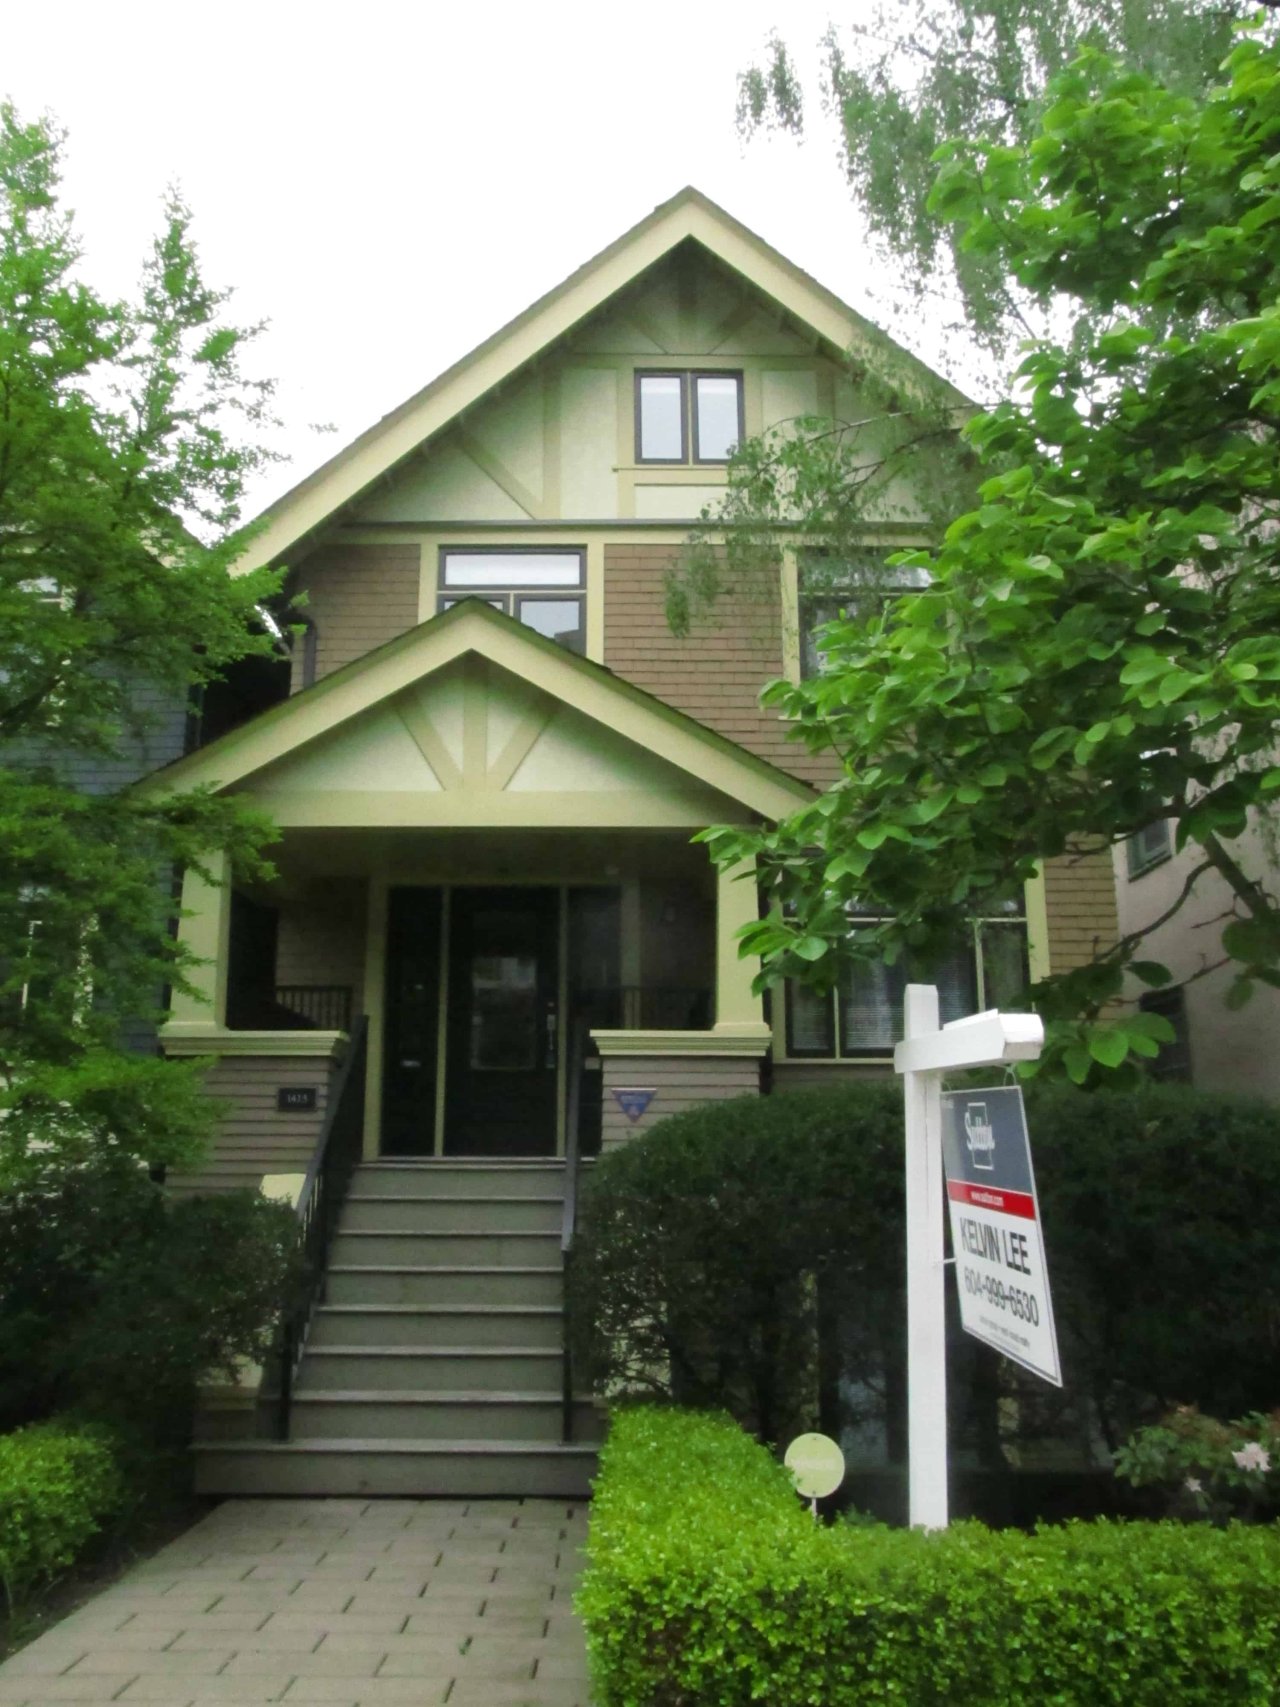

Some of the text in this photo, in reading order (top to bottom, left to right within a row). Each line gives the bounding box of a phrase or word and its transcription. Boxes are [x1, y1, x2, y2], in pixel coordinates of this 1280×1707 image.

[959, 1216, 1032, 1276] KELVIN LEE
[964, 1265, 1039, 1328] 604-999-6530
